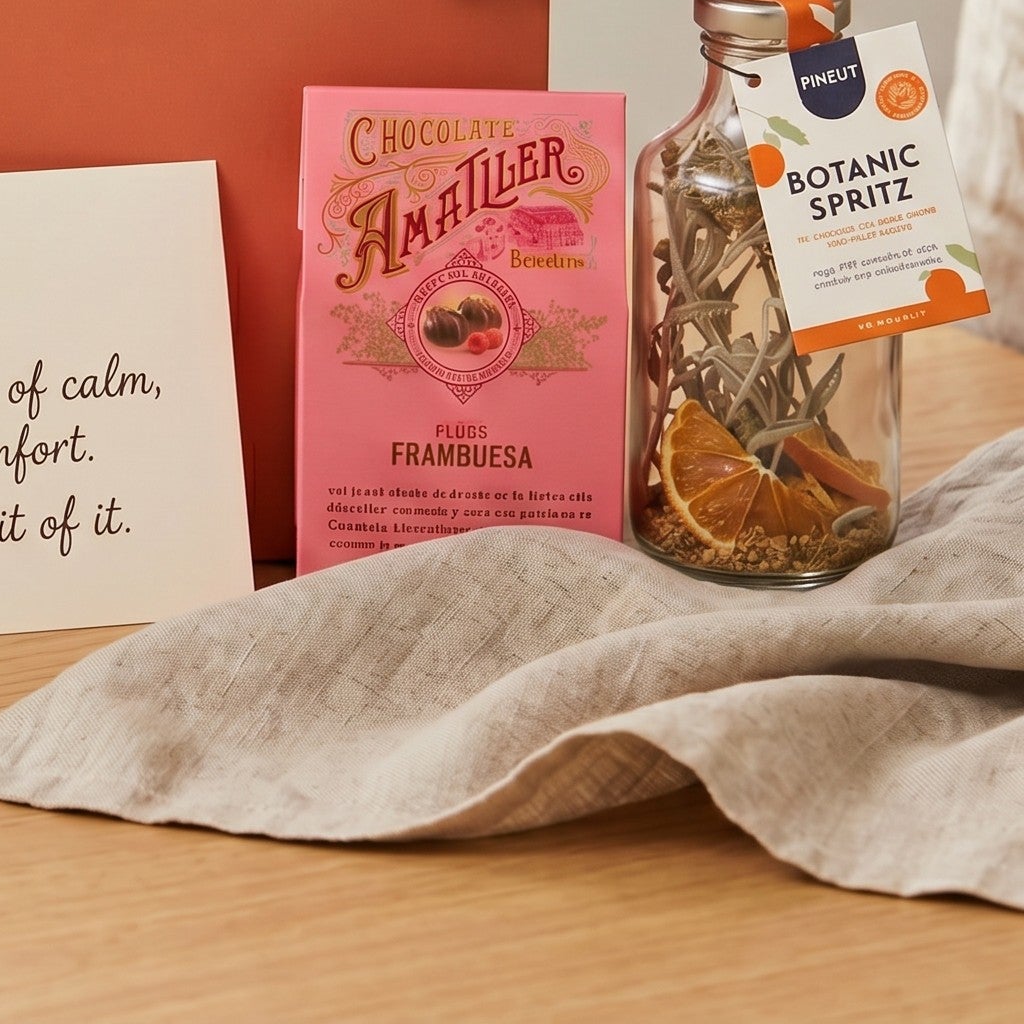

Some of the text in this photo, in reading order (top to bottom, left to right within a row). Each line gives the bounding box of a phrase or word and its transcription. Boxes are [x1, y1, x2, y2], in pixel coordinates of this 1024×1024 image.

[800, 64, 858, 91] PINEUT
[349, 116, 515, 166] CHOCOLATE
[786, 143, 920, 195] BOTANIC
[809, 177, 913, 221] SPRITZ
[8, 360, 46, 420] of
[61, 353, 162, 400] calm,
[392, 442, 533, 469] FRAMBUESA
[39, 495, 80, 556] of
[93, 497, 132, 536] it.
